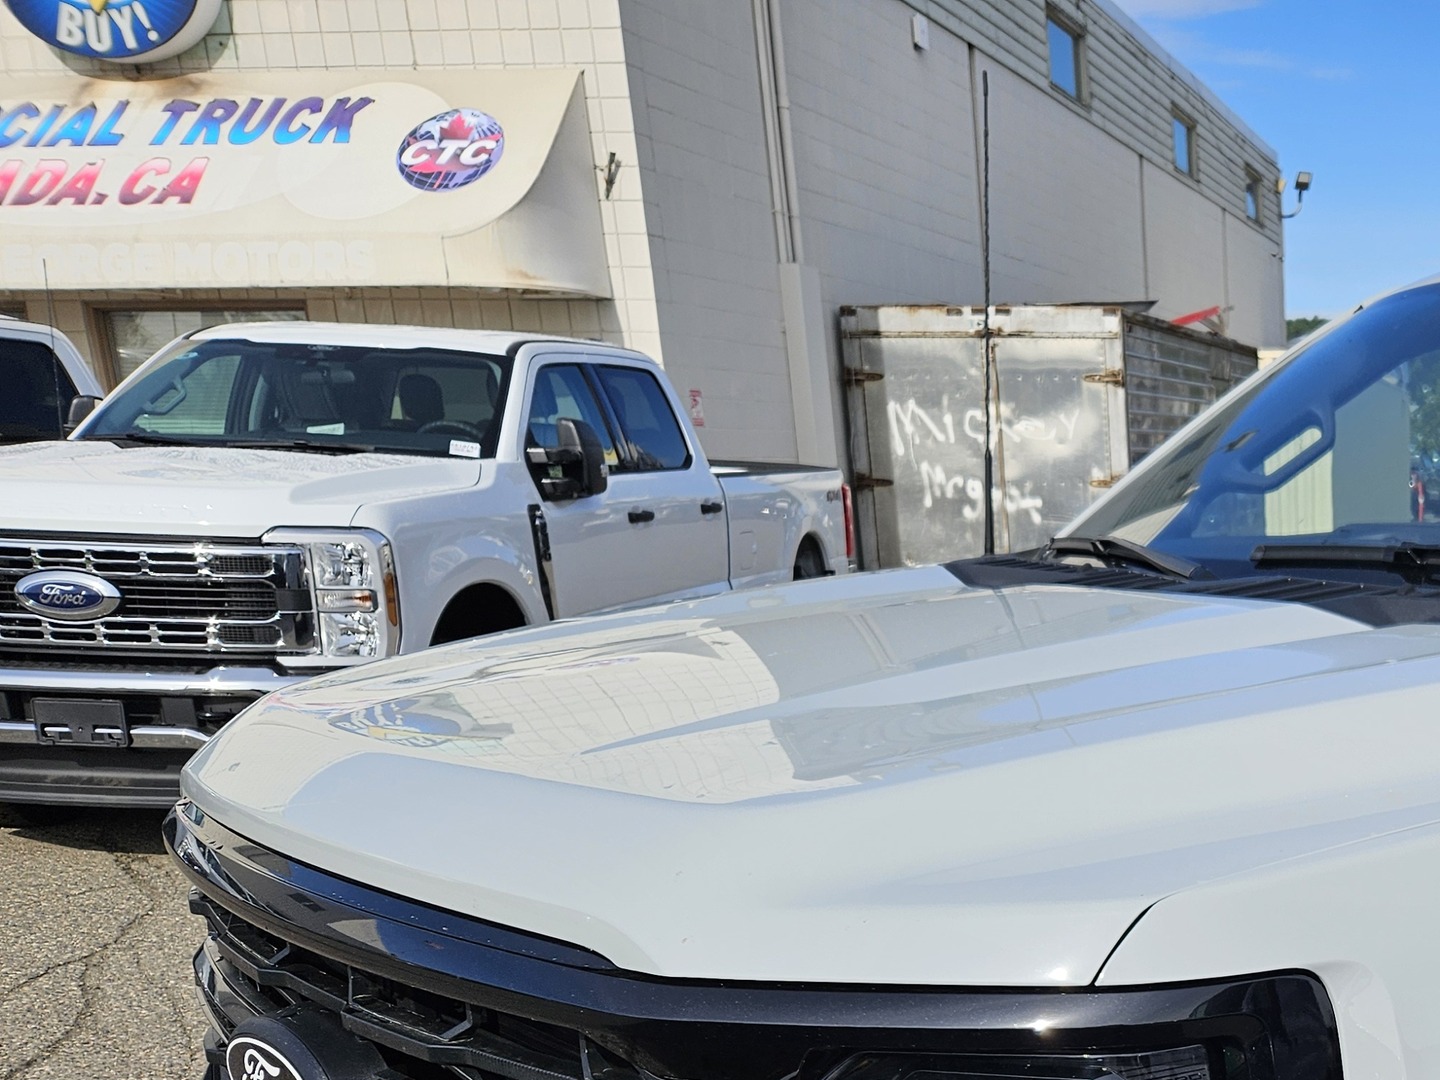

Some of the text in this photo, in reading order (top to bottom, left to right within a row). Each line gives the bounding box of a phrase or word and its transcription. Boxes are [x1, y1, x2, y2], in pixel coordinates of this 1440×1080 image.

[56, 1, 159, 52] BUY!
[0, 96, 375, 148] CIAL TRUCK
[400, 139, 497, 166] CTC
[39, 584, 86, 606] Ford
